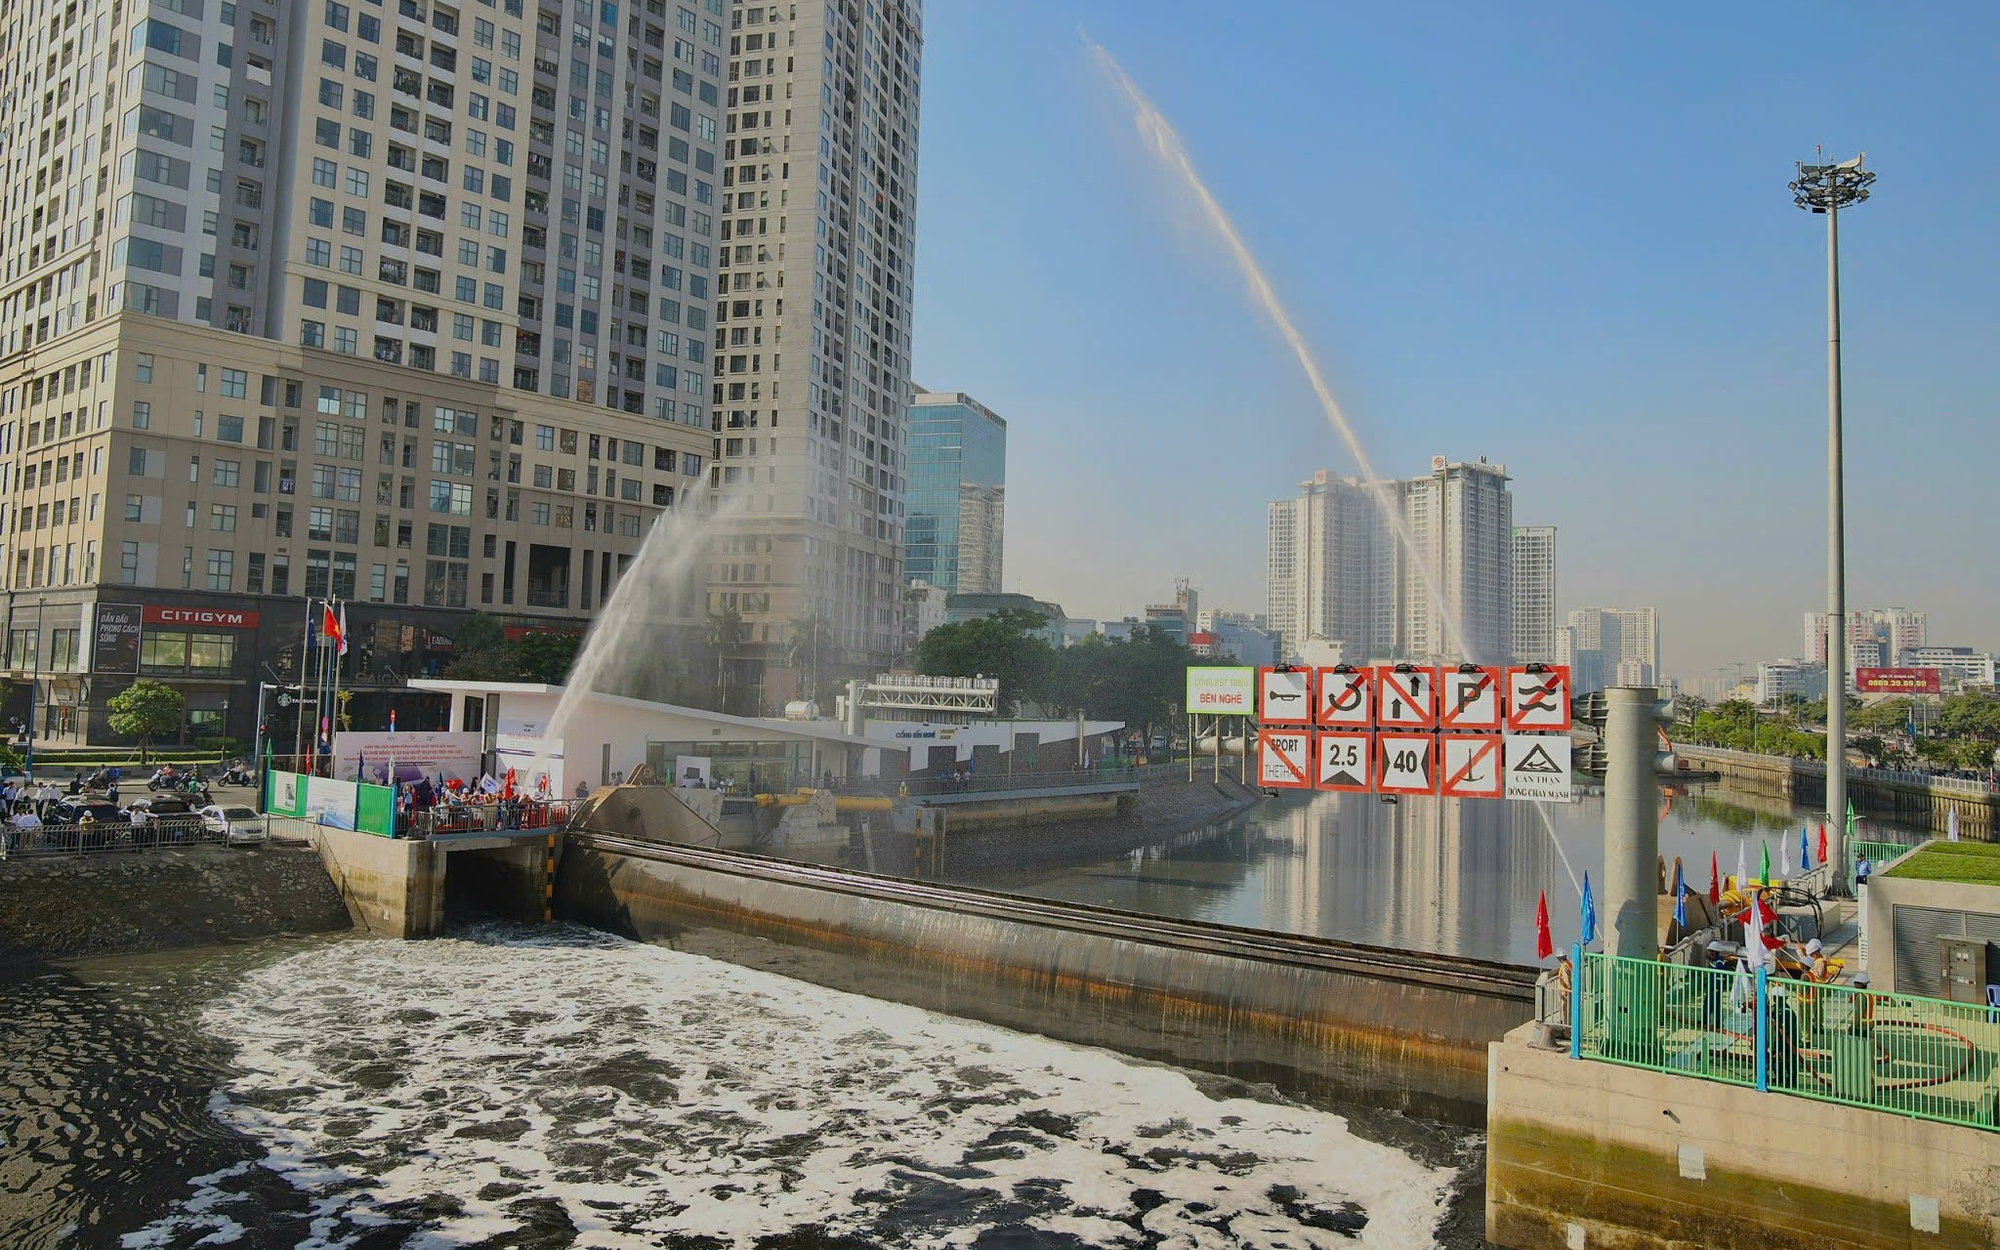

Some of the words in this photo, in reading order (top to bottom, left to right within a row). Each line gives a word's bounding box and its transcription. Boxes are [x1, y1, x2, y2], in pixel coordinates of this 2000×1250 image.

[161, 610, 243, 624] CITIGYM
[1271, 738, 1299, 752] SPORT
[1329, 744, 1357, 767] 2.5
[1393, 750, 1417, 773] 40
